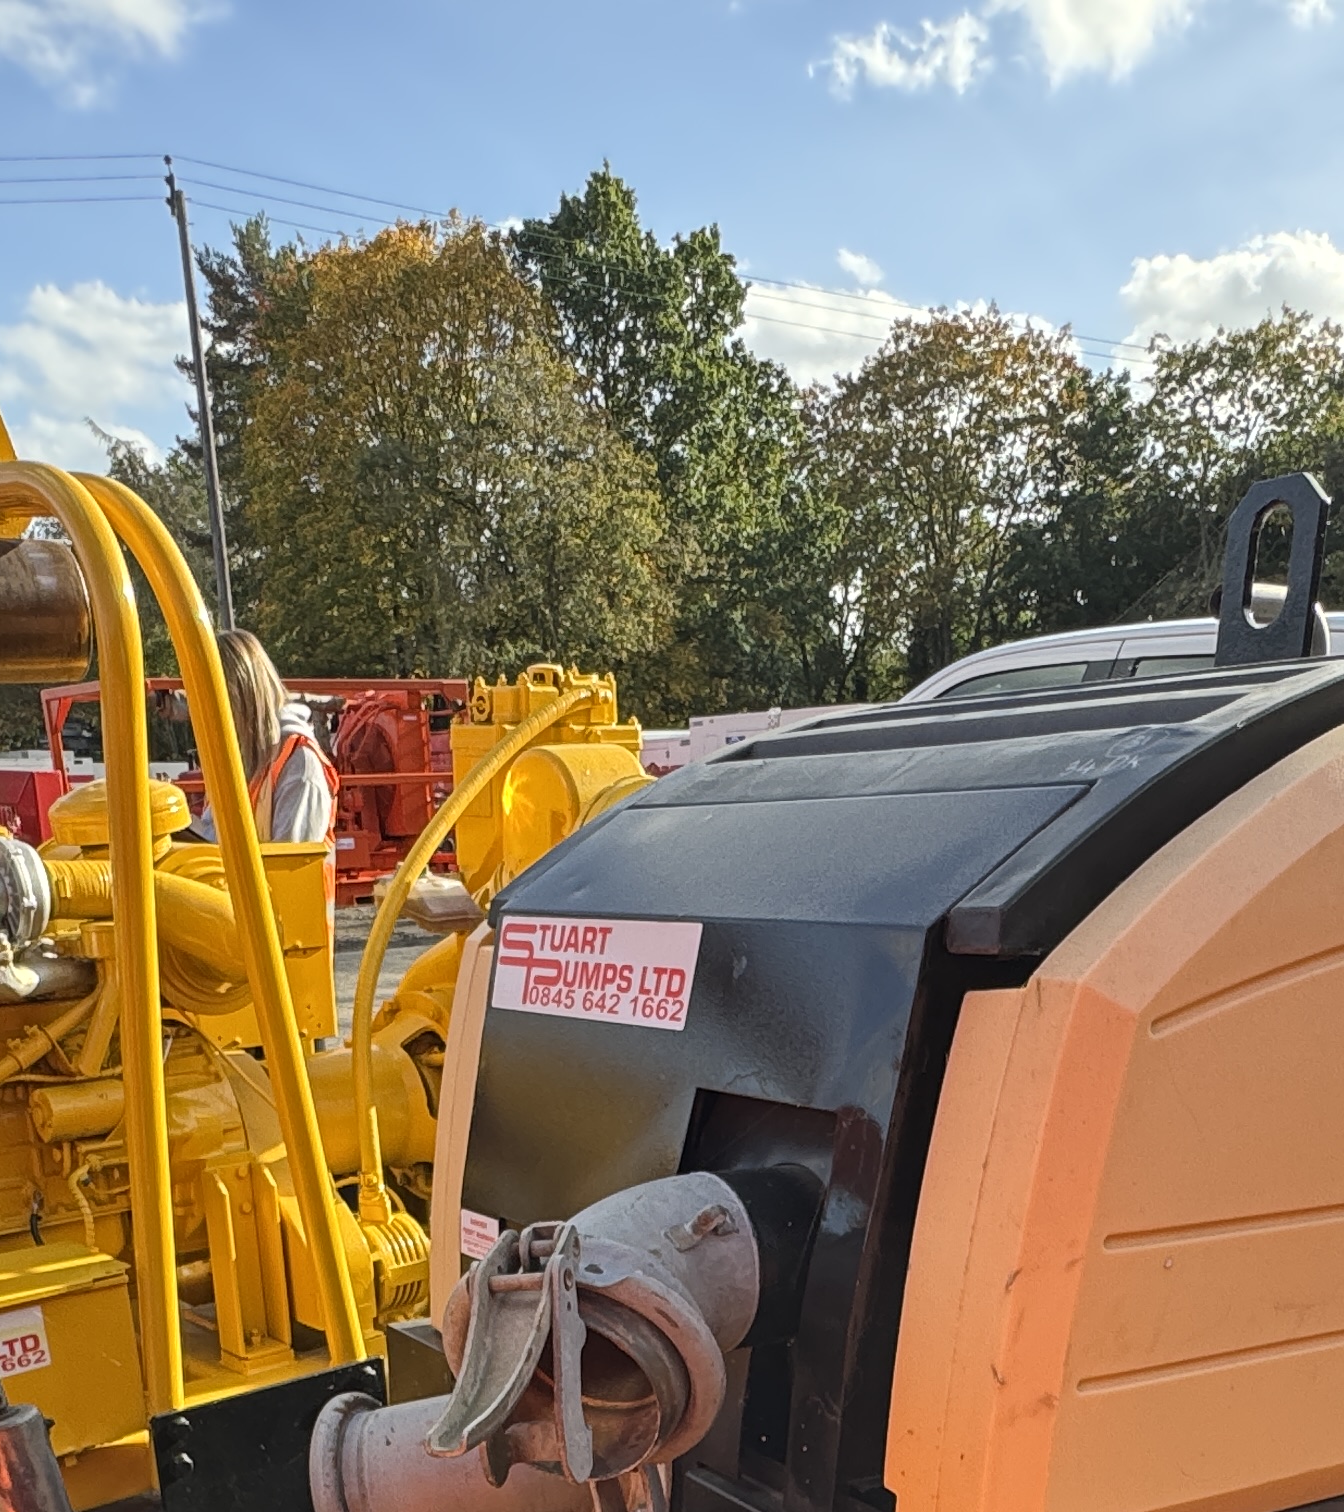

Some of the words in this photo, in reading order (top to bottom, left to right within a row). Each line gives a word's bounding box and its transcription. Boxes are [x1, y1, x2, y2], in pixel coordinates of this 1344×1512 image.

[502, 923, 613, 959] STUART
[499, 956, 633, 1004] PUMPS
[638, 965, 686, 998] LTD
[529, 985, 576, 1010] 0845
[582, 990, 621, 1015] 642
[629, 995, 685, 1022] 1662
